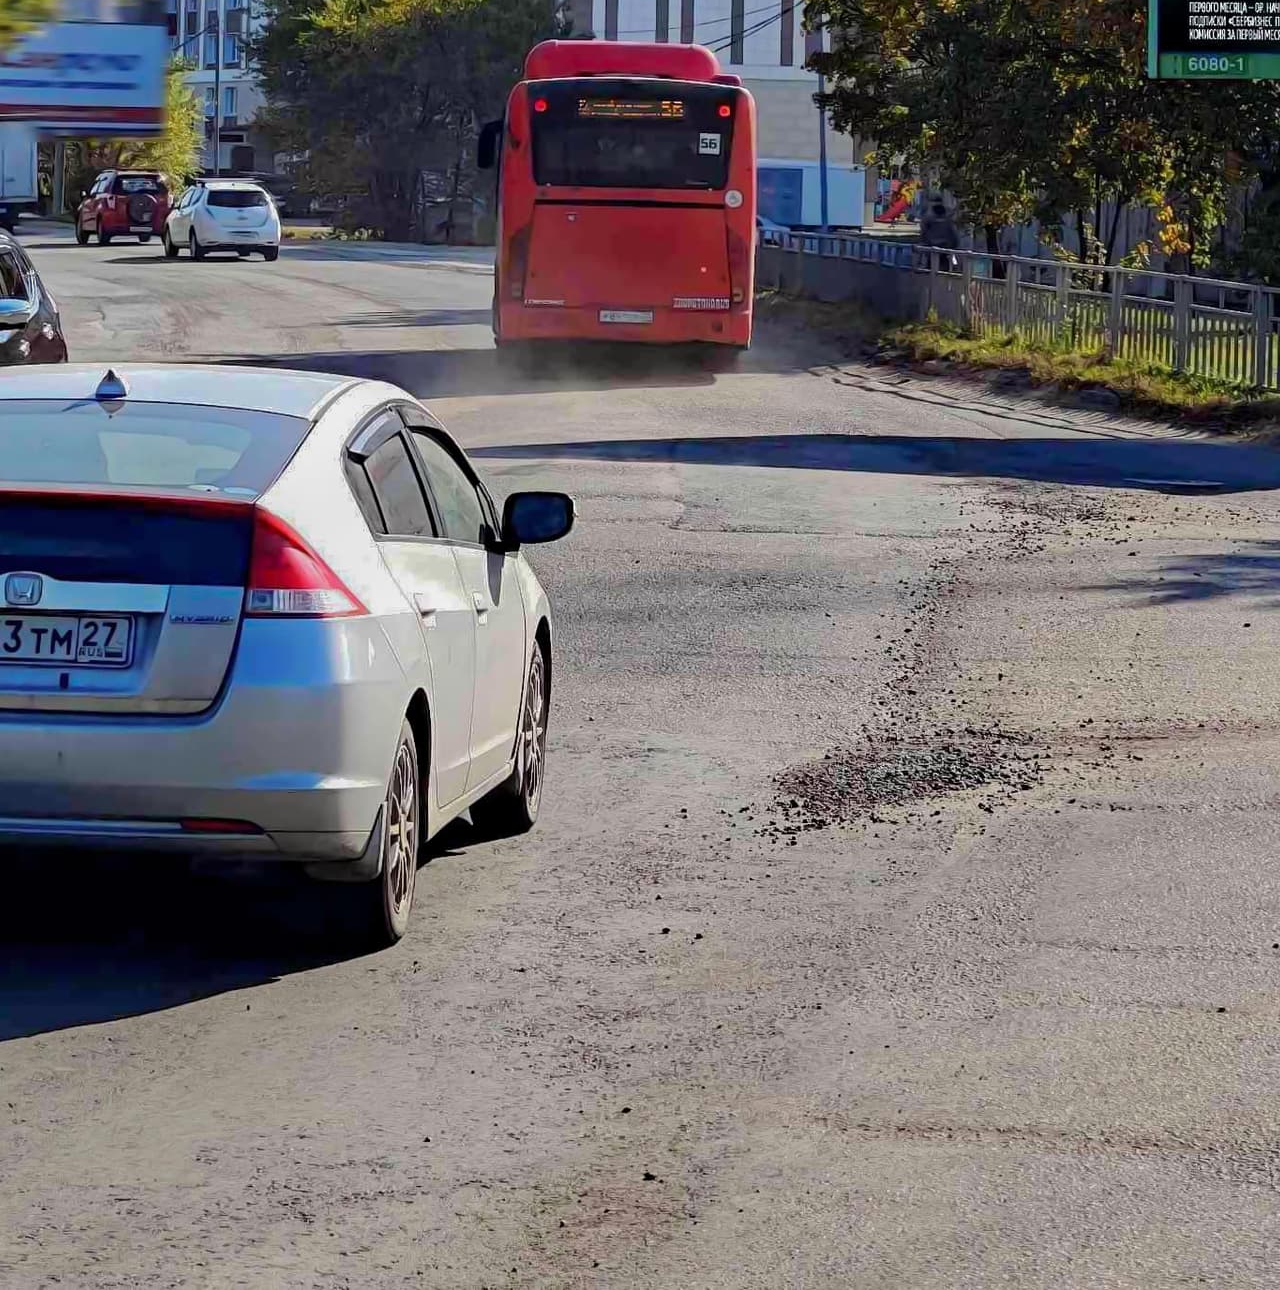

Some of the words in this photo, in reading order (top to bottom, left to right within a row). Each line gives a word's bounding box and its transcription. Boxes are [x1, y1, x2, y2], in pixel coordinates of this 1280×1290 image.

[1188, 2, 1219, 13] ПЕРВОГО
[1219, 2, 1248, 14] МЕСЯЦА
[1188, 16, 1227, 28] ПОДПИСКИ
[1188, 30, 1226, 40] КОМИССИЯ
[1226, 30, 1236, 40] ЗА
[1236, 28, 1263, 40] ПЕРВЫЙ
[1188, 57, 1244, 71] 6080-1
[700, 138, 717, 149] 56
[82, 621, 118, 647] 27
